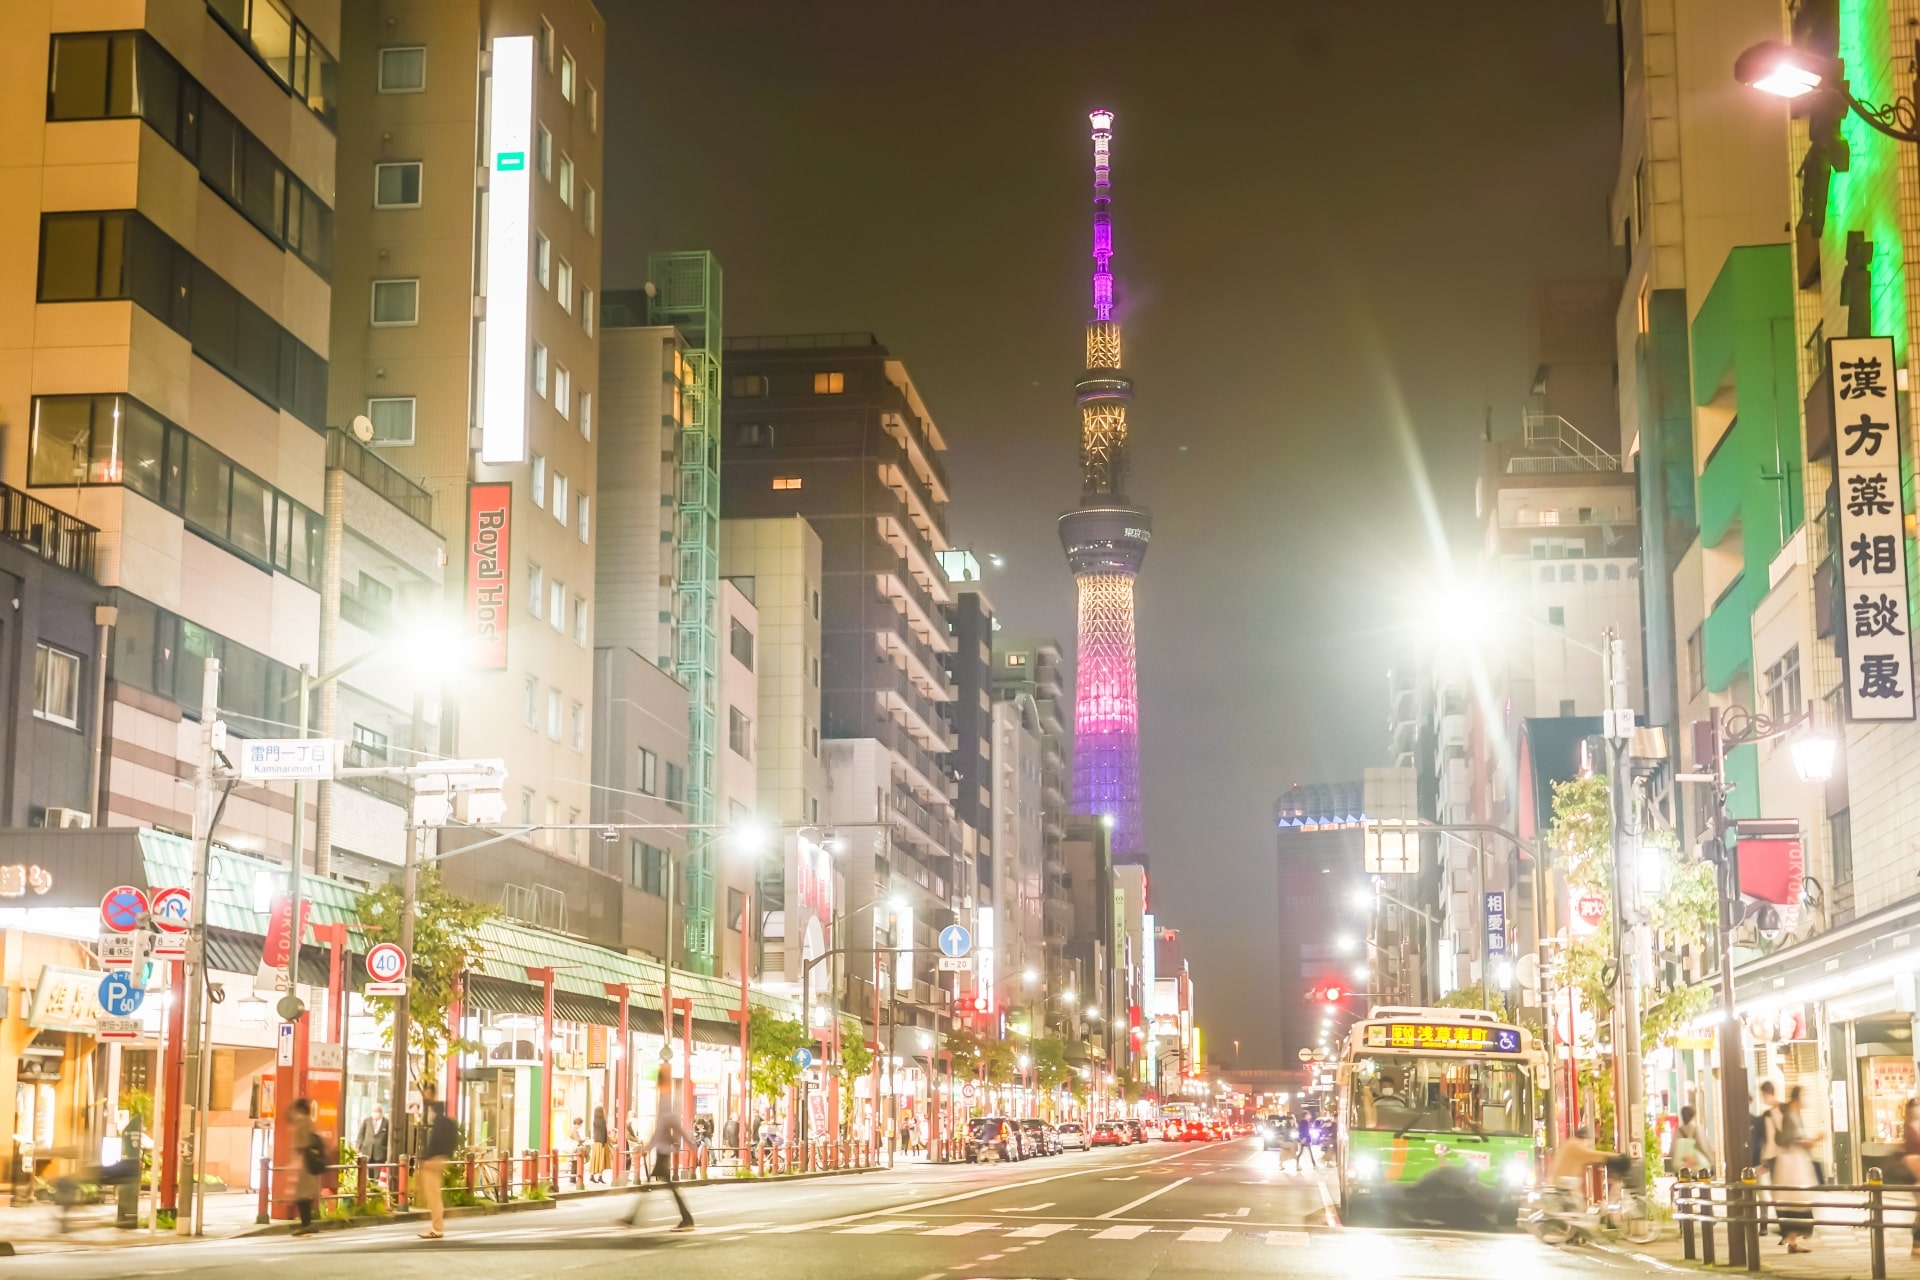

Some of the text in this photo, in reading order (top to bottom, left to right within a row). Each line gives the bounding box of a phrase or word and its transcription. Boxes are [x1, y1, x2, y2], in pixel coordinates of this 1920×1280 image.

[473, 508, 505, 645] Royal Host
[251, 745, 325, 761] 雷門一丁目
[254, 765, 313, 773] Kaminarimon
[1787, 841, 1803, 893] TOKYO
[274, 896, 293, 992] TOKYO 2020
[376, 954, 397, 972] 40
[107, 982, 128, 1012] P
